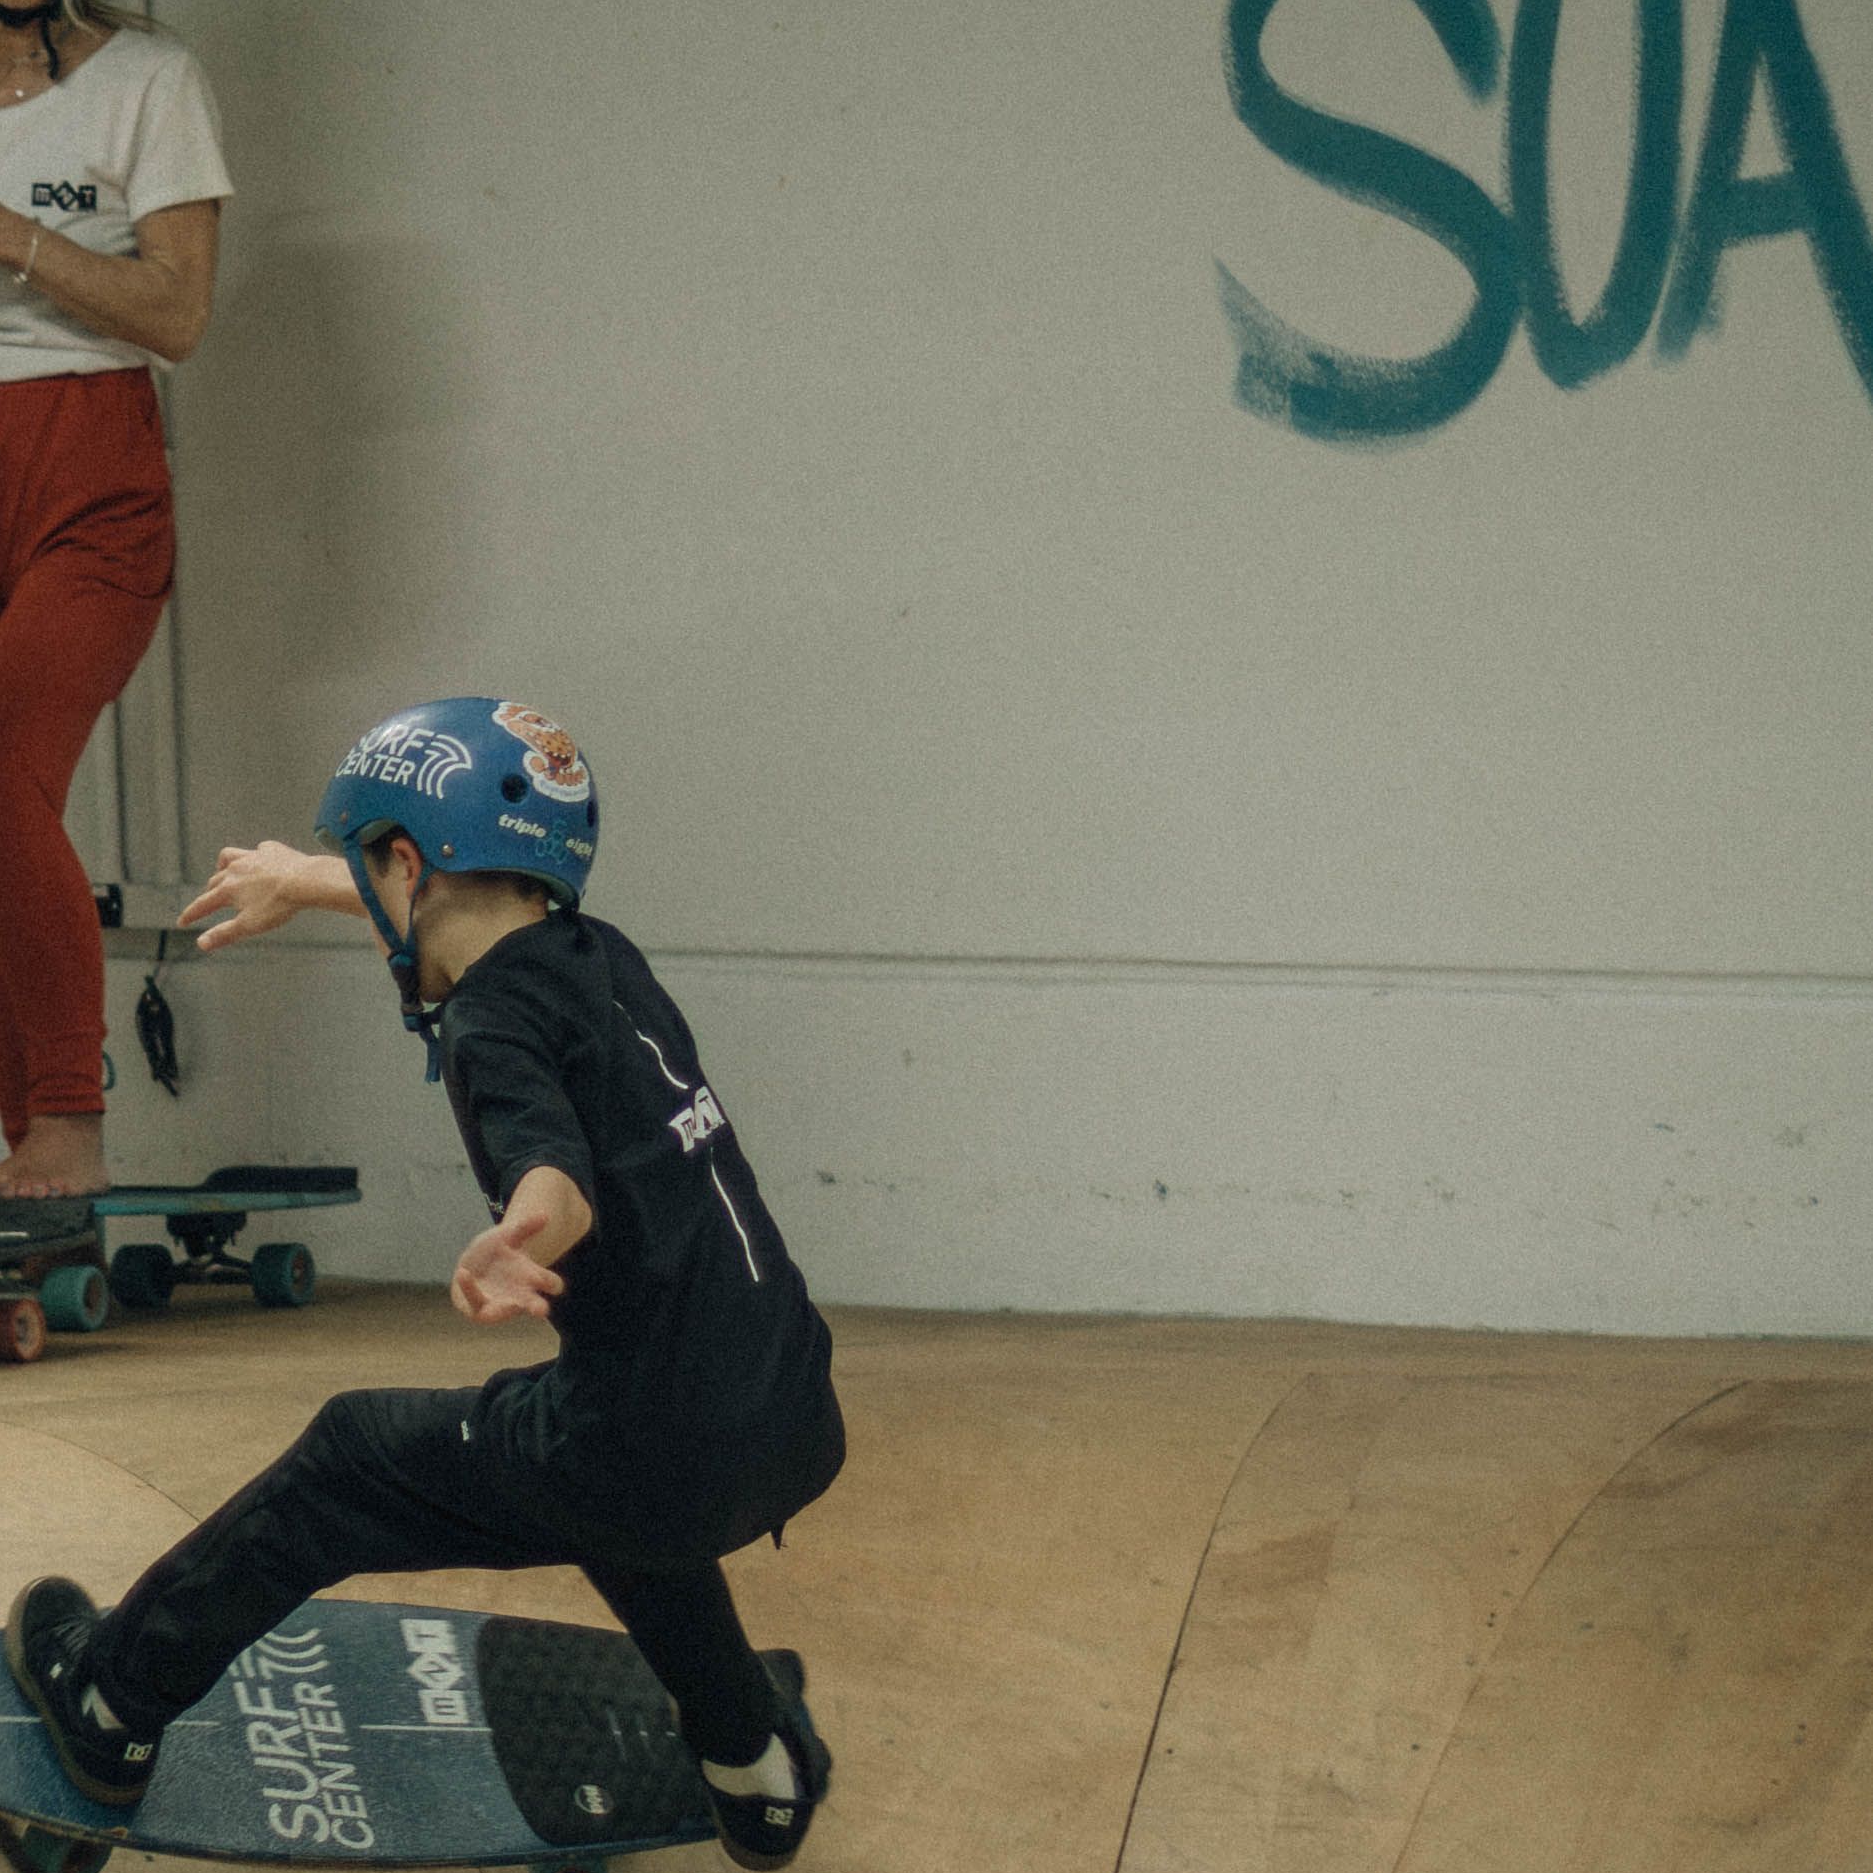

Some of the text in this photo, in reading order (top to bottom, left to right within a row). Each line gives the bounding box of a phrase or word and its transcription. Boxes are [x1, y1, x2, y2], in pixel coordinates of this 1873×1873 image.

[335, 748, 416, 786] CENTER
[498, 814, 546, 838] triple
[233, 1681, 330, 1844] SURF
[292, 1680, 375, 1849] CENTER
